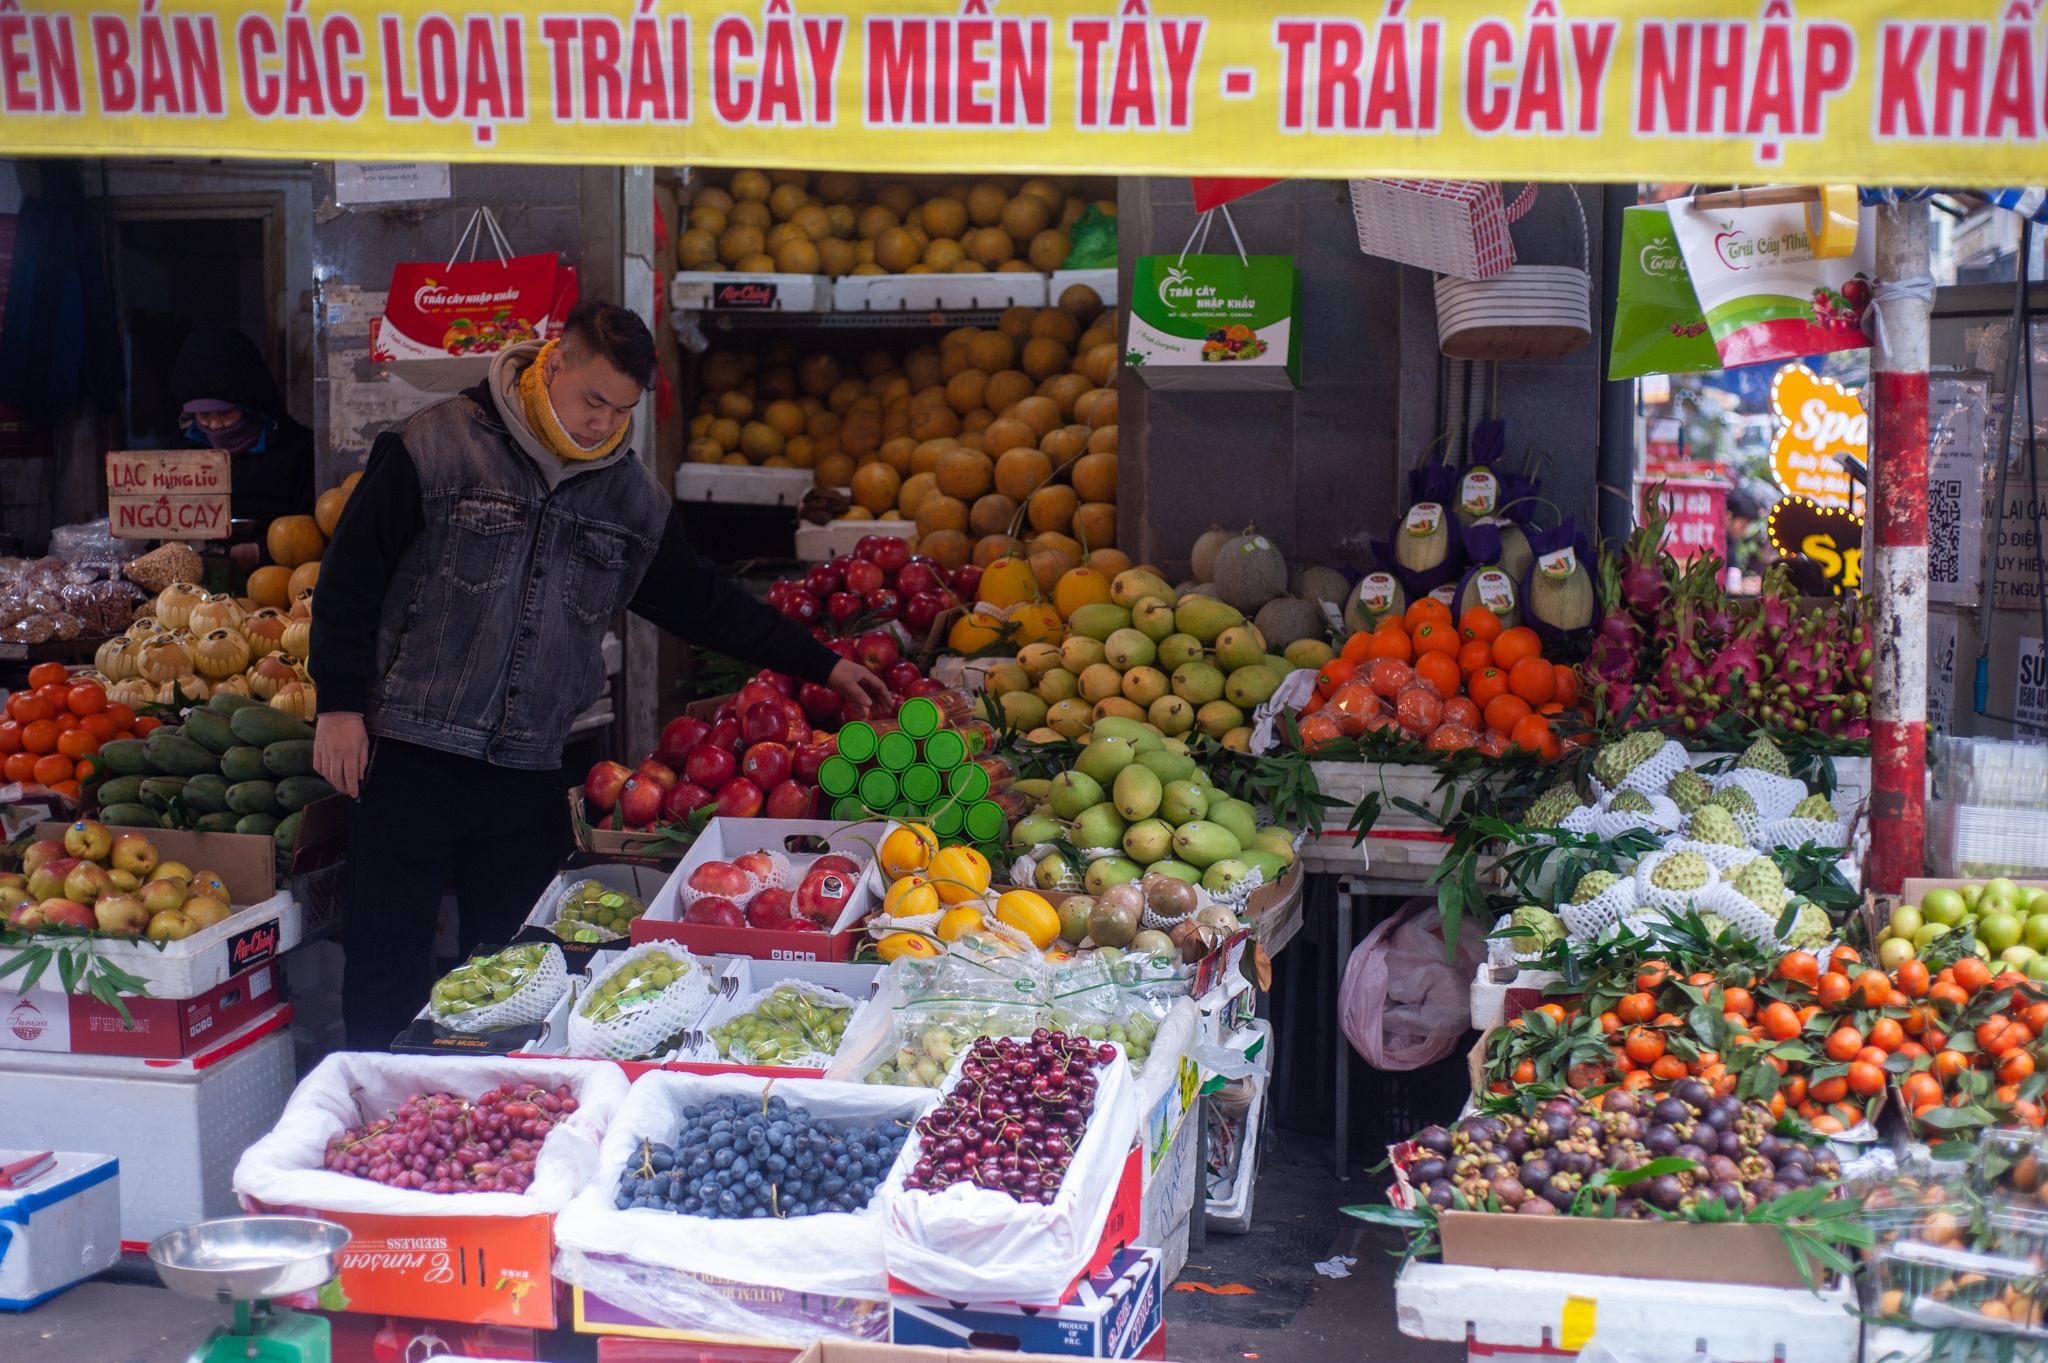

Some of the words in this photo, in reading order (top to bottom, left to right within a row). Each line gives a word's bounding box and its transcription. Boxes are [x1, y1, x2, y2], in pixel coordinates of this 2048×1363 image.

[92, 0, 223, 115] BÁN
[239, 0, 363, 118] CÁC
[379, 16, 524, 142] LOẠI
[543, 0, 688, 120] TRÁI
[713, 0, 844, 123] CÂY
[1072, 0, 1203, 127] TÂY
[1226, 72, 1251, 93] -
[1278, 0, 1439, 129] TRÁI
[1466, 0, 1617, 132] CÂY
[1637, 1, 1852, 160] NHẬP
[1727, 240, 1754, 259] Trái
[1757, 237, 1780, 257] Cây
[1782, 254, 1816, 265] NEWZEALAN
[423, 295, 445, 305] TRÁI
[447, 293, 465, 304] CÂY
[465, 291, 492, 305] NHẬP
[493, 286, 520, 302] KHẨU
[1169, 285, 1192, 297] TRÁI
[1196, 284, 1216, 297] CÂY
[1196, 297, 1225, 311] NHẬP
[1227, 295, 1255, 309] KHẨU
[113, 463, 146, 492] LẠC
[120, 495, 172, 528] NGÔ
[179, 504, 223, 528] CAY
[7, 1013, 48, 1027] Tunisia
[90, 1016, 101, 1031] SOFT
[103, 1016, 115, 1031] SEED
[433, 1038, 457, 1046] SHINE
[386, 1237, 448, 1250] SEEDLESS
[343, 1252, 454, 1284] Crimson
[1058, 1322, 1088, 1331] PRODUCE
[1069, 1330, 1079, 1338] OF
